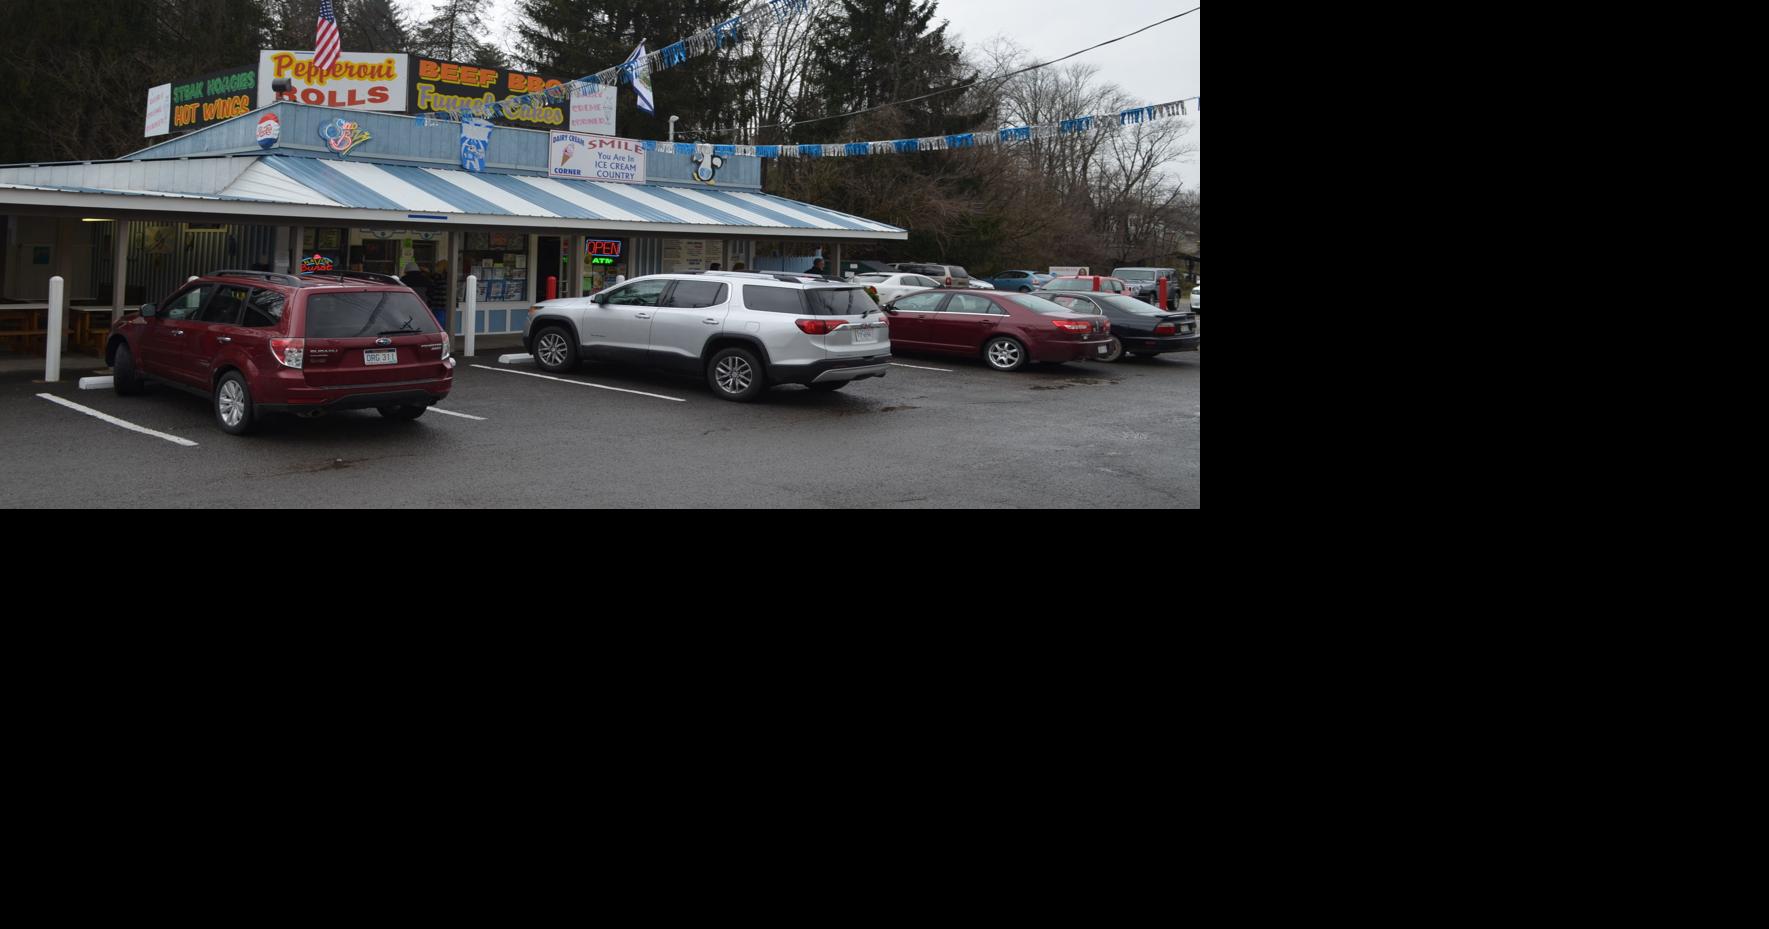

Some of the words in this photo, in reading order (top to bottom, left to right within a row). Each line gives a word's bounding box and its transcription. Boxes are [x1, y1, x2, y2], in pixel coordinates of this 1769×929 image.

[271, 52, 398, 86] Pepperoni
[419, 59, 498, 88] BEEF
[173, 80, 204, 103] STEAK
[207, 70, 256, 96] HOAGIES
[174, 102, 200, 127] HOT
[202, 94, 250, 122] WINGS
[416, 82, 496, 115] Funnel
[501, 94, 564, 125] Cakes
[552, 134, 568, 144] DAIRY
[587, 138, 644, 155] SMILE
[597, 151, 611, 160] You
[613, 153, 626, 162] Are
[554, 167, 582, 176] CORNER
[595, 160, 608, 169] ICE
[609, 161, 637, 172] CREAM
[596, 170, 635, 180] COUNTRY
[587, 240, 620, 255] OPEN
